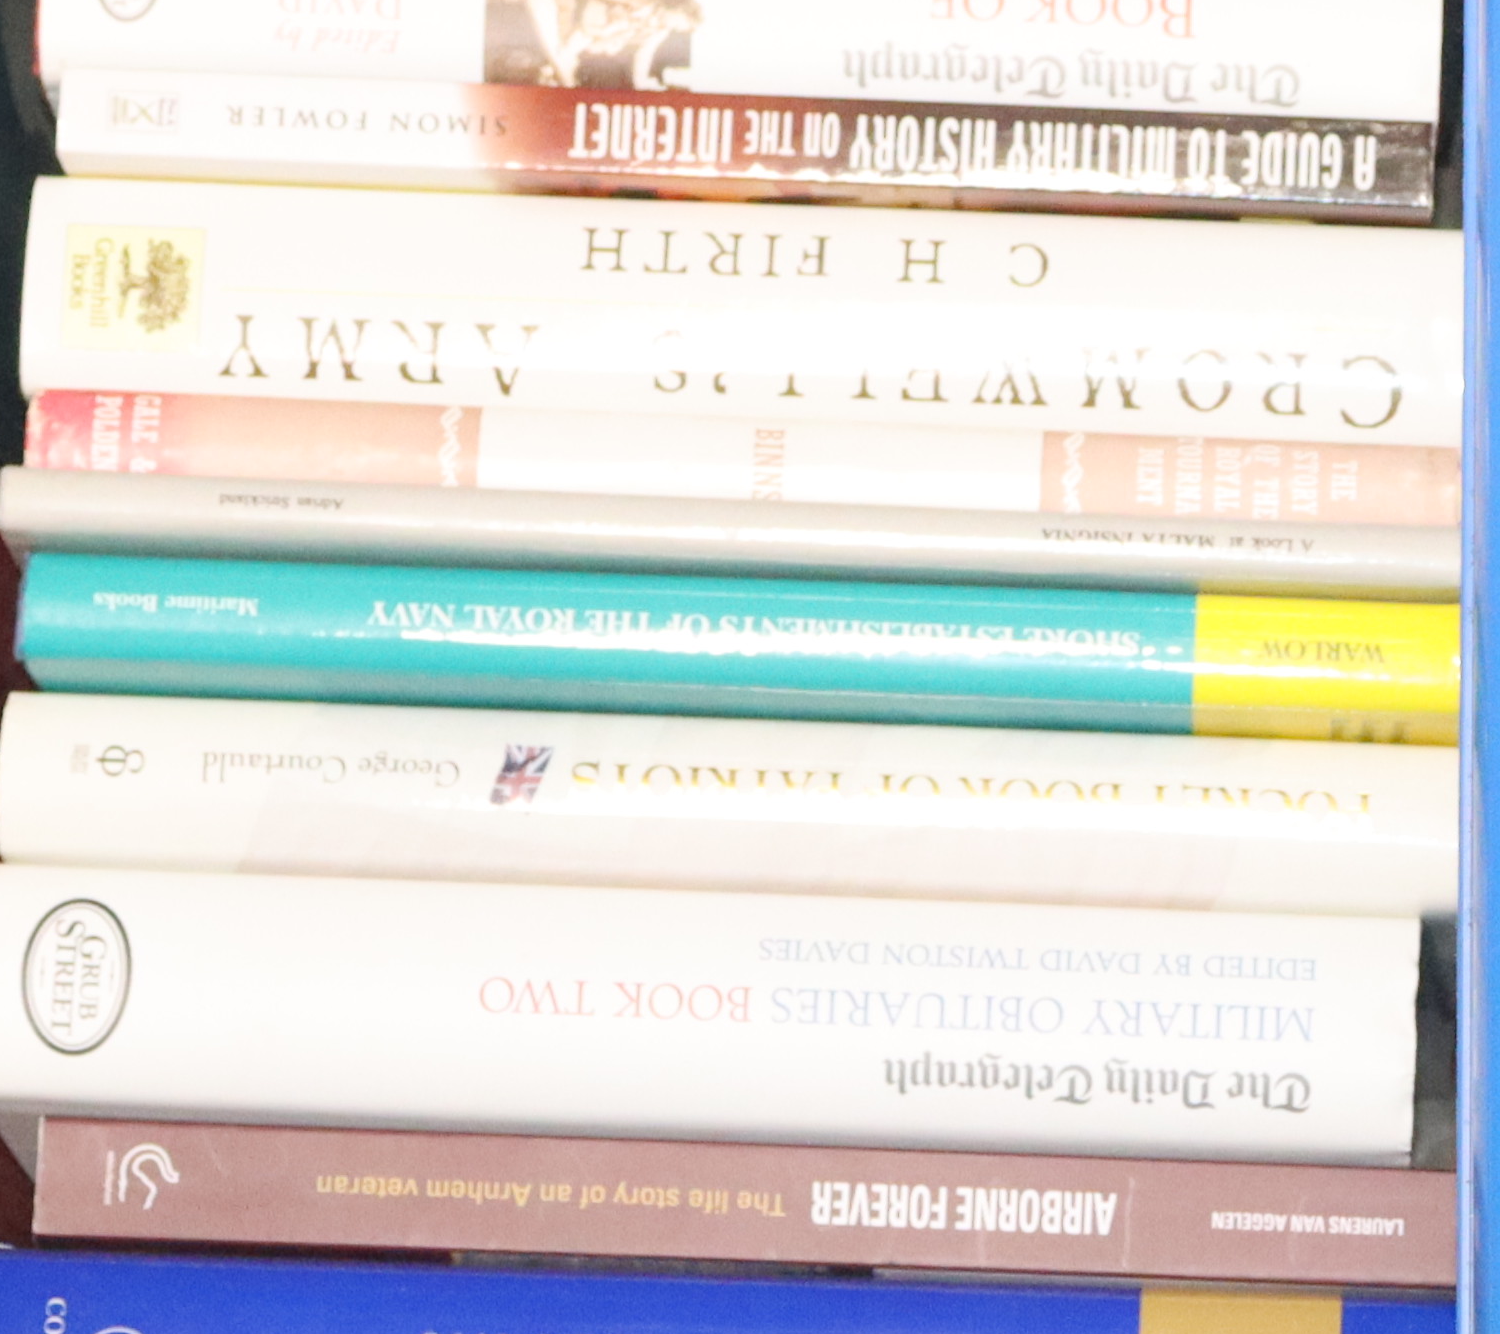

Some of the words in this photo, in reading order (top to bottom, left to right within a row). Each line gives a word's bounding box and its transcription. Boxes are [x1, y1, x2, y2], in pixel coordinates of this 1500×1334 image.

[479, 977, 593, 1015] TWO
[614, 982, 751, 1022] BOOK
[771, 987, 1064, 1032] OBITUARIES
[1084, 1000, 1313, 1042] MILITARY
[886, 1053, 1092, 1105] Telegraph
[1105, 1065, 1214, 1109] Daily
[1227, 1073, 1310, 1113] The
[317, 1176, 417, 1197] veteran
[427, 1180, 532, 1207] Arnhem
[541, 1179, 573, 1204] an
[580, 1186, 605, 1208] of
[613, 1182, 680, 1208] story
[689, 1189, 728, 1213] life
[737, 1191, 785, 1217] The
[812, 1183, 946, 1228] FOREVER
[960, 1184, 1117, 1238] AIRBORNE
